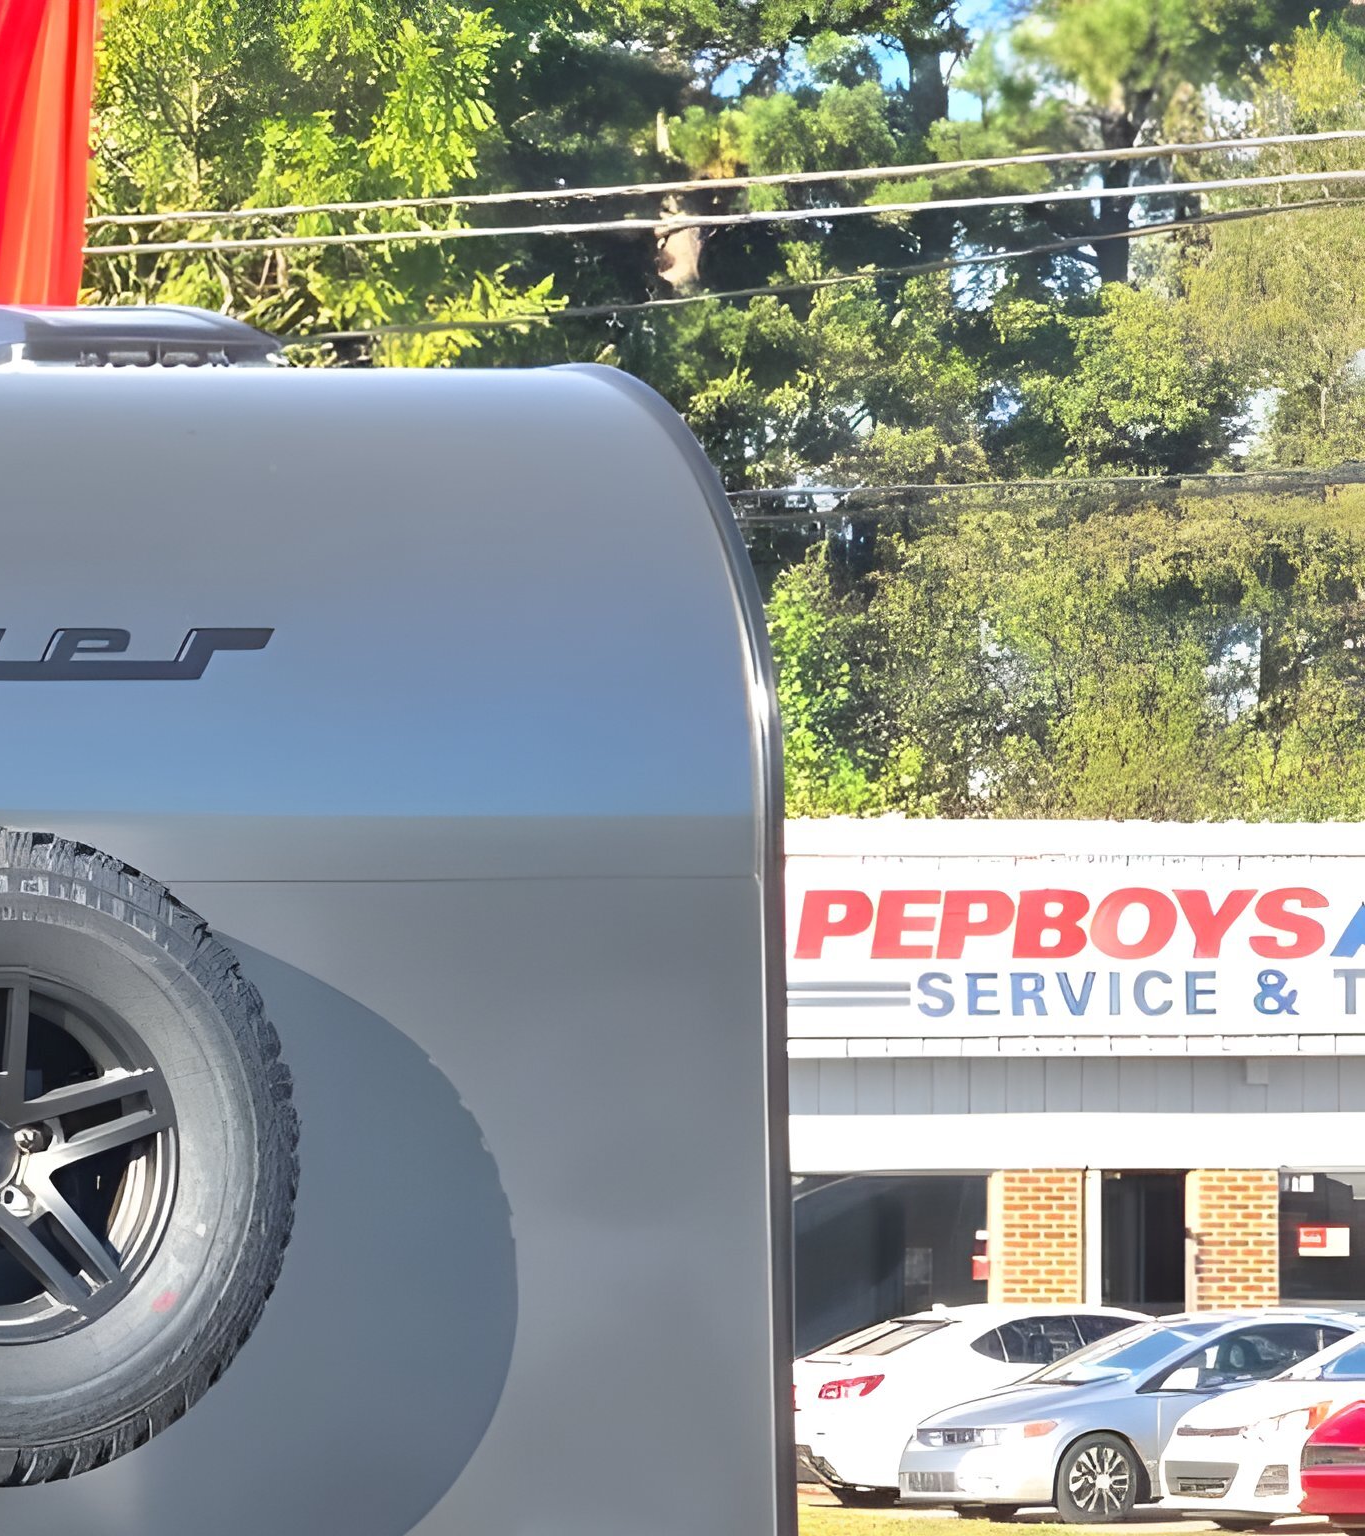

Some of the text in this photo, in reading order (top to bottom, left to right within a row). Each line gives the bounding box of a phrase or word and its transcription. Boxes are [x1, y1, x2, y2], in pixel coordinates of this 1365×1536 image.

[794, 887, 1330, 960] PEPBOYS
[917, 970, 1218, 1017] SERVICE
[1253, 969, 1300, 1015] &
